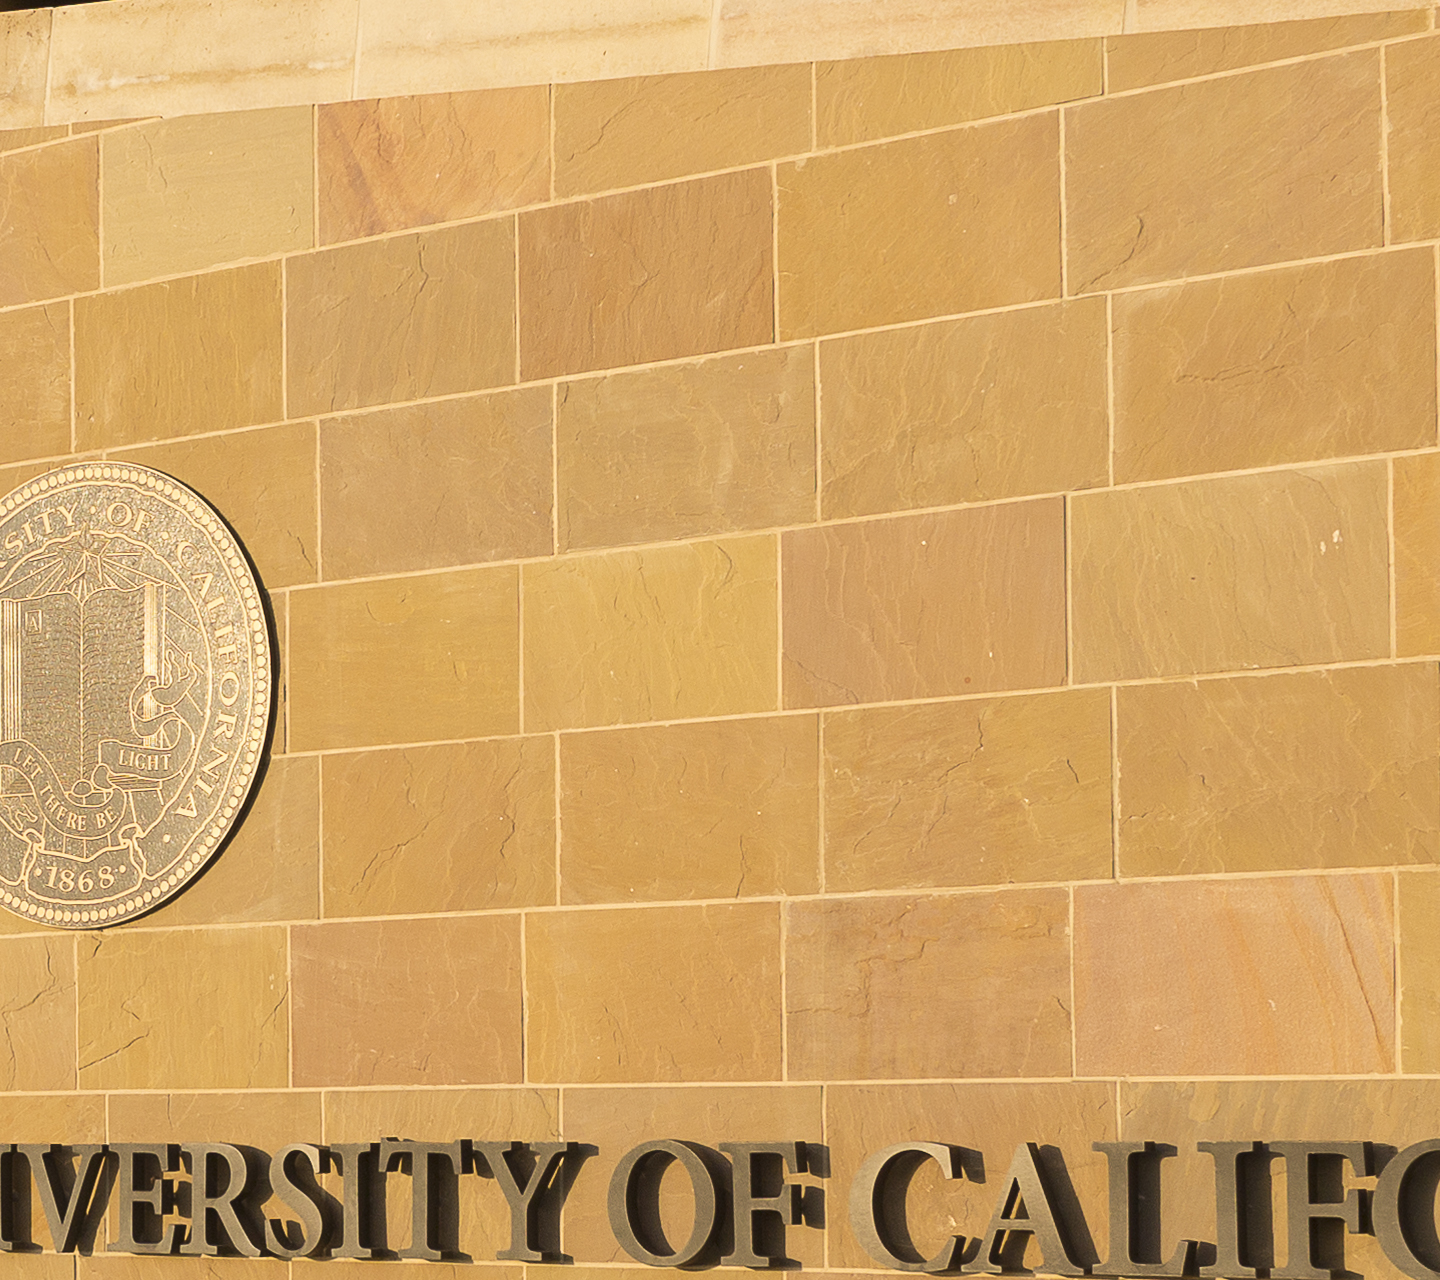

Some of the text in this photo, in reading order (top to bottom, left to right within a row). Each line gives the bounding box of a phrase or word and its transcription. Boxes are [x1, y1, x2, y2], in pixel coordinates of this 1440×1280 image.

[106, 501, 153, 533] OF
[173, 539, 241, 821] CALIFORNIA
[13, 747, 171, 832] LET THERE BE LIGHT
[45, 865, 114, 894] 1868
[607, 1138, 812, 1269] OF
